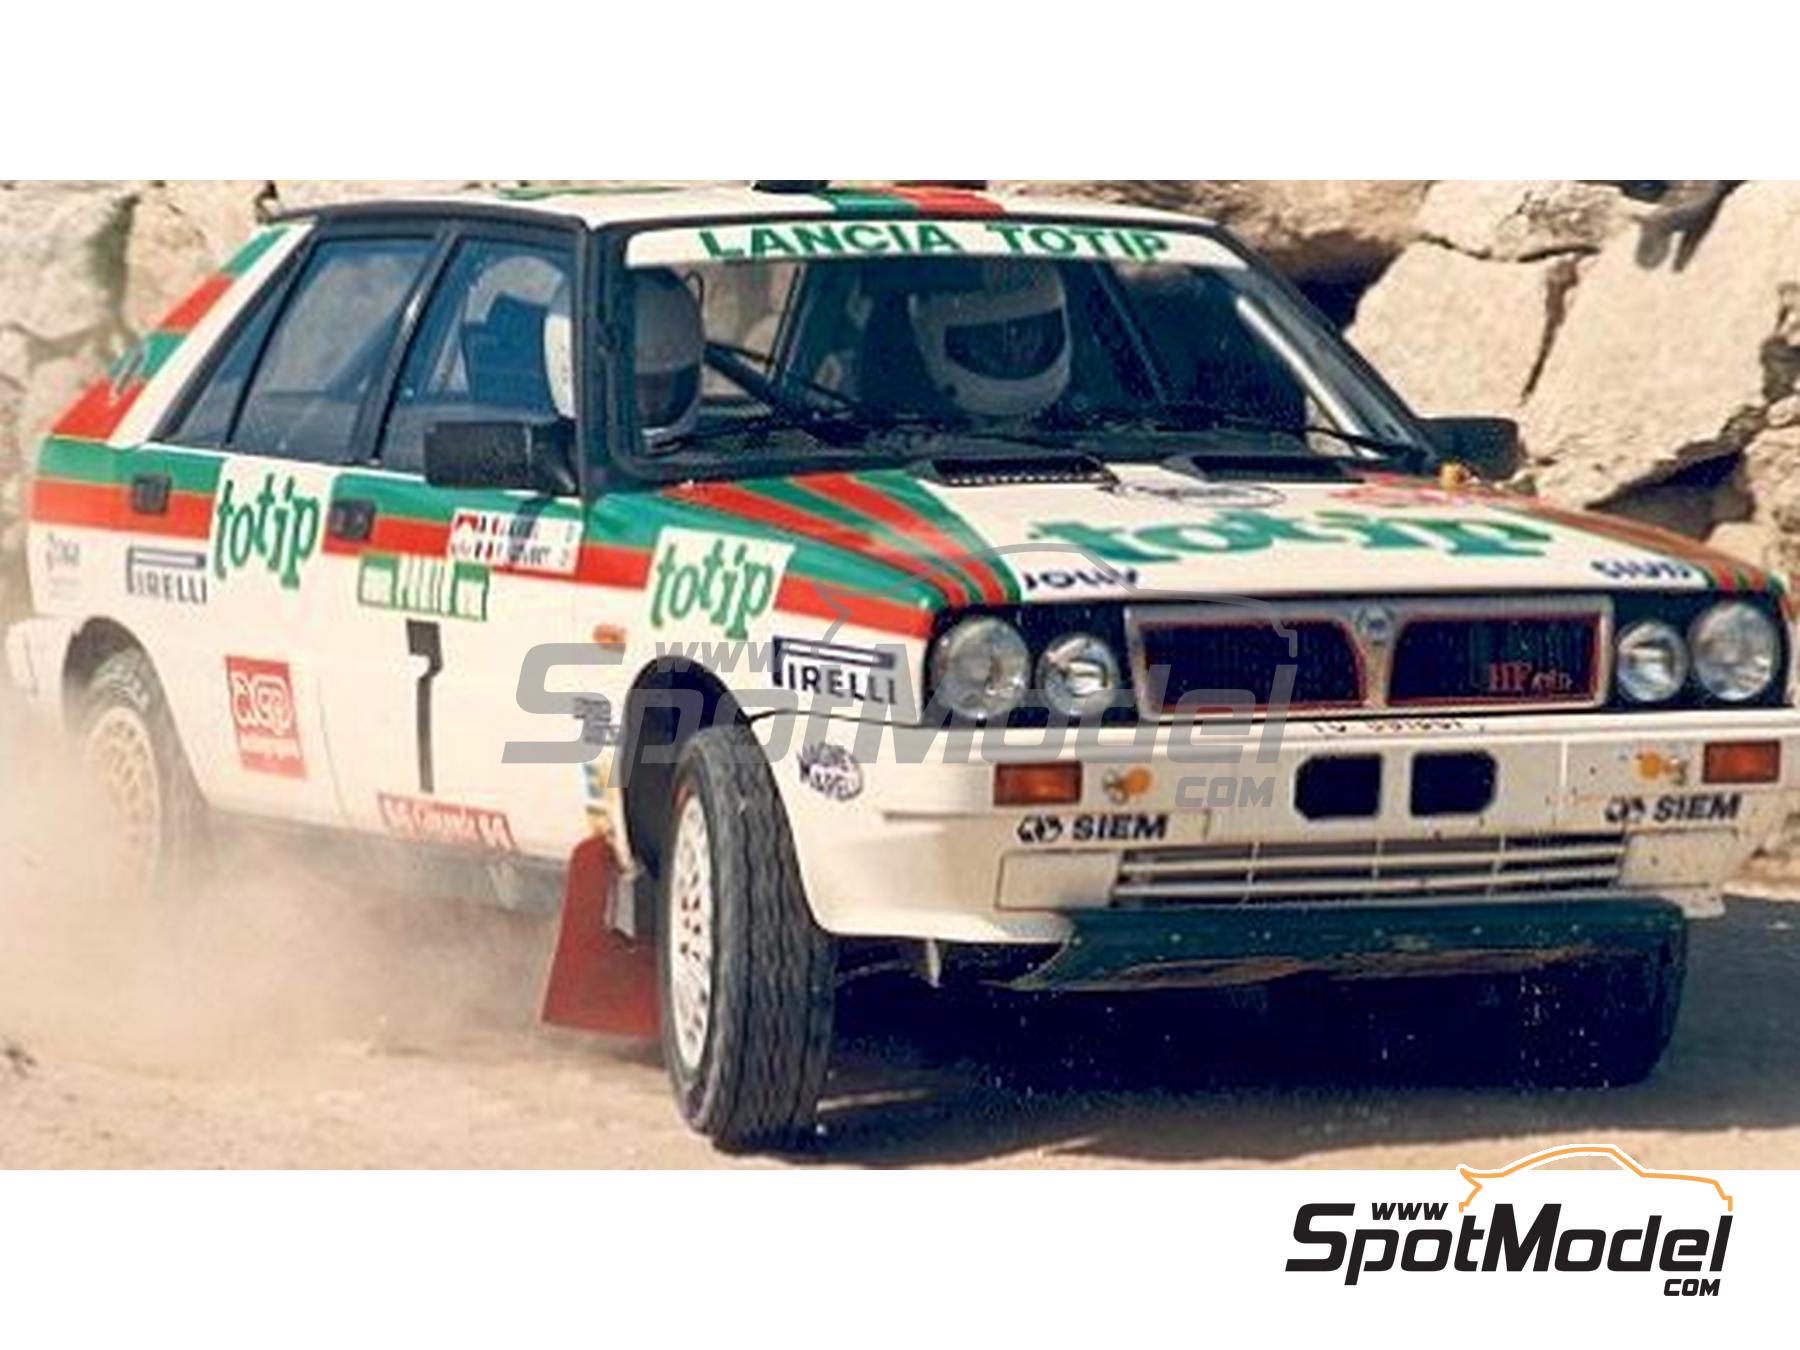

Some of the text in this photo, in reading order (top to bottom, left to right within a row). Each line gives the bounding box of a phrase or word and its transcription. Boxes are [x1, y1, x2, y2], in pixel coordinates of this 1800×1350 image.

[699, 221, 1170, 264] LANCIA TOTIP
[213, 472, 320, 590] totip
[126, 545, 207, 604] PIRELLI
[650, 539, 774, 640] totip
[772, 636, 897, 704] PIRELLI
[405, 619, 443, 793] 7
[1072, 813, 1169, 841] SIEM
[1653, 794, 1743, 822] SIEM
